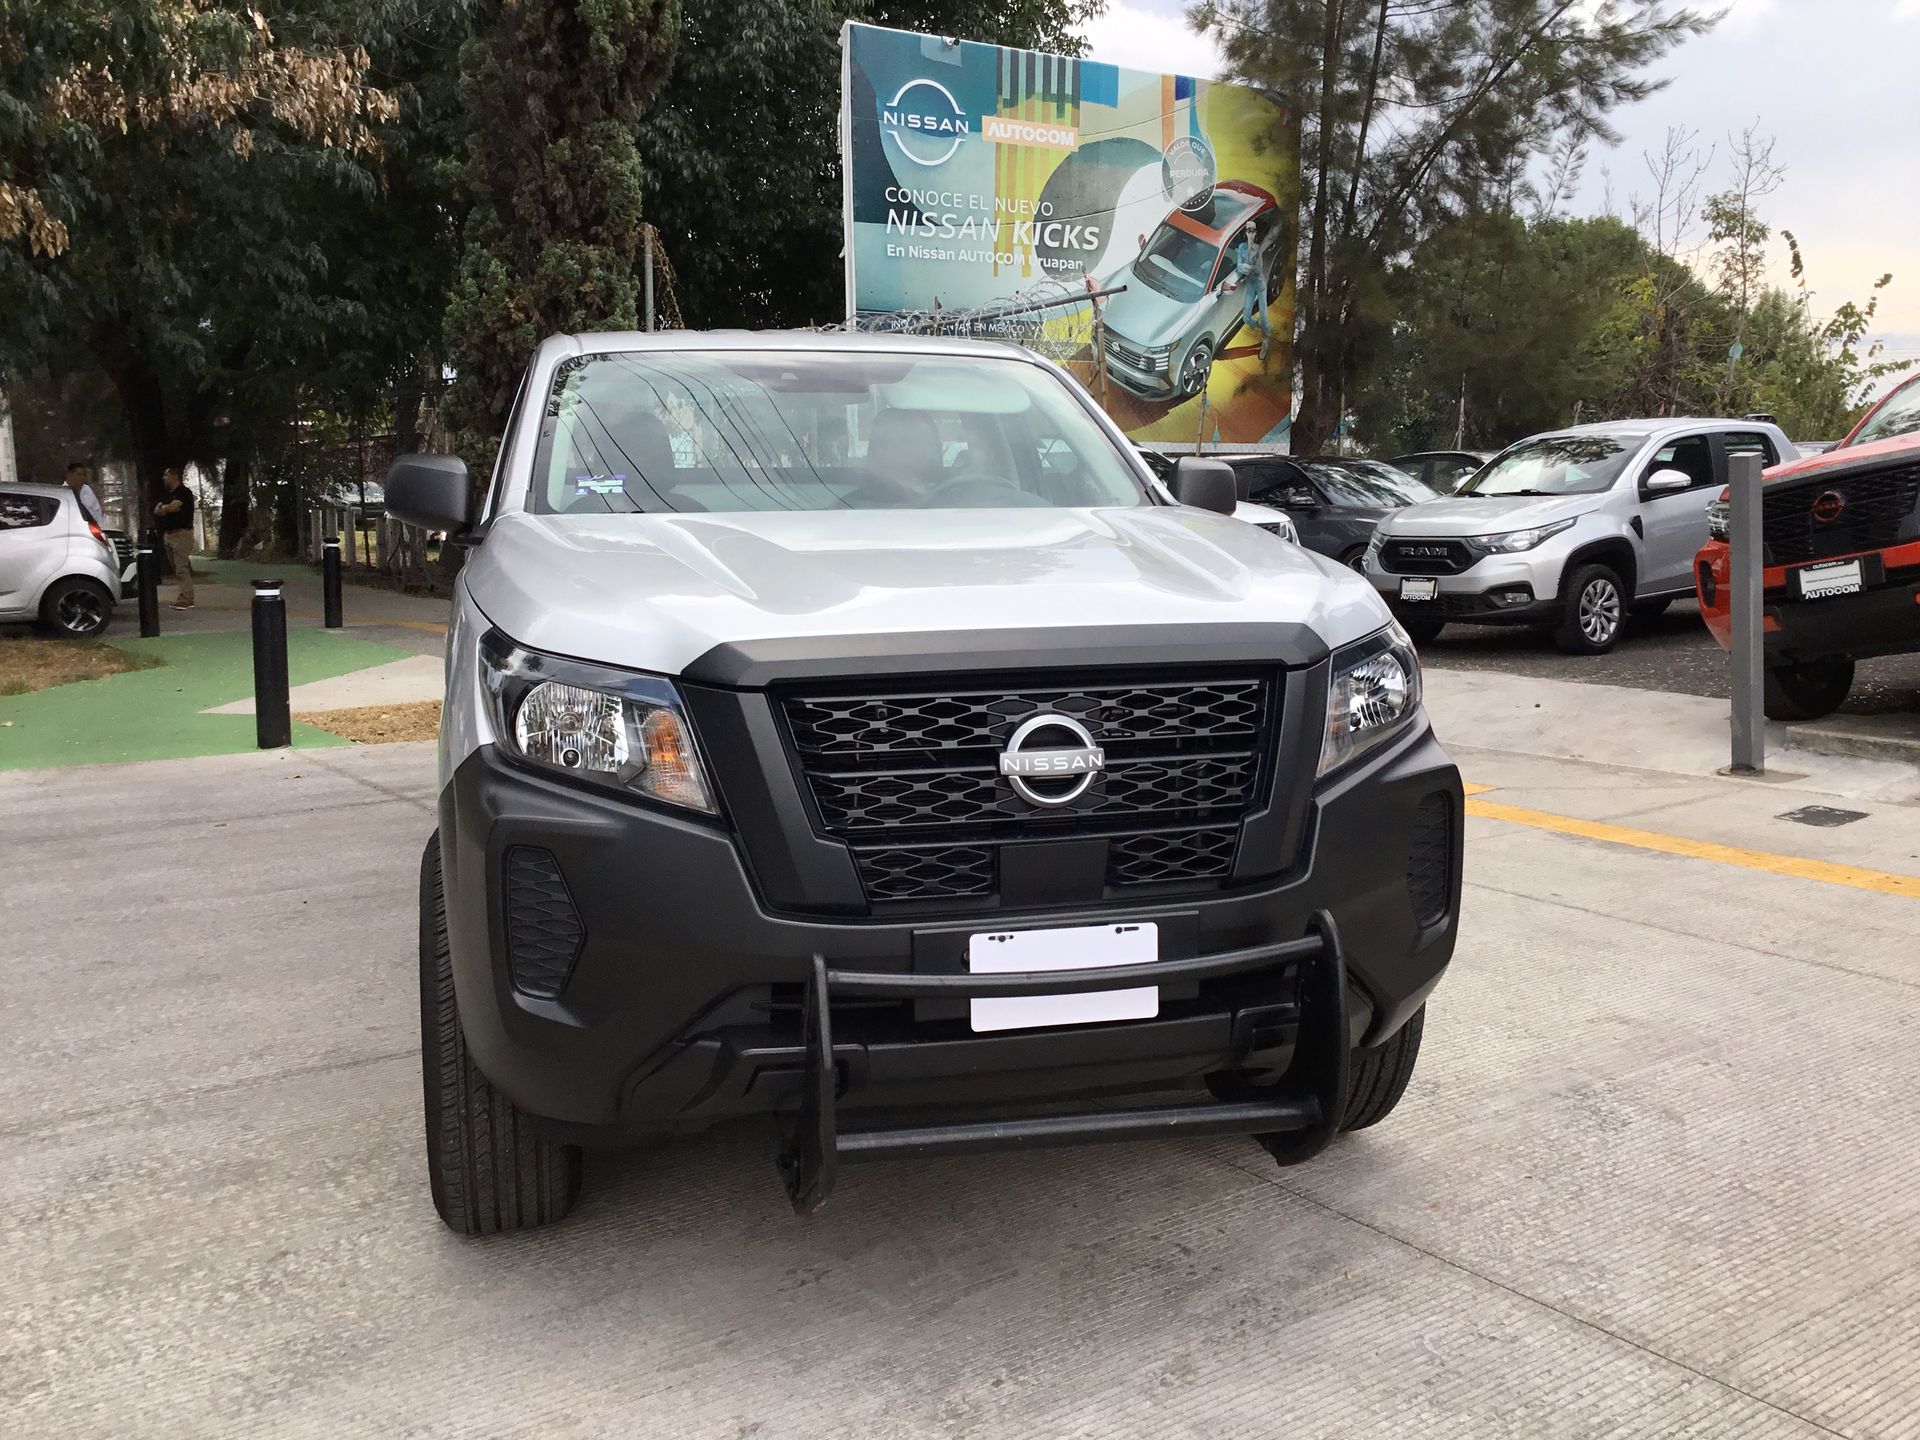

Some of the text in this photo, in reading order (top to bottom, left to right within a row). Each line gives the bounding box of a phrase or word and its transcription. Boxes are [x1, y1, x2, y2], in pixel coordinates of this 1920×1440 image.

[883, 110, 969, 134] NISSAN
[988, 122, 1075, 146] AUTOCOM
[1191, 141, 1206, 155] QUE
[1169, 168, 1209, 178] PERDURA
[884, 186, 1053, 216] CONOCE EL NUEVO
[886, 208, 1100, 251] NISSAN KICKS
[887, 243, 905, 257] En
[909, 245, 955, 261] Nissan
[958, 249, 1025, 266] AUTOCOM
[1399, 547, 1448, 556] RAM
[1400, 592, 1431, 601] AUTOCOM
[1805, 583, 1860, 600] AUTOCOM
[1004, 753, 1103, 771] NISSAN
